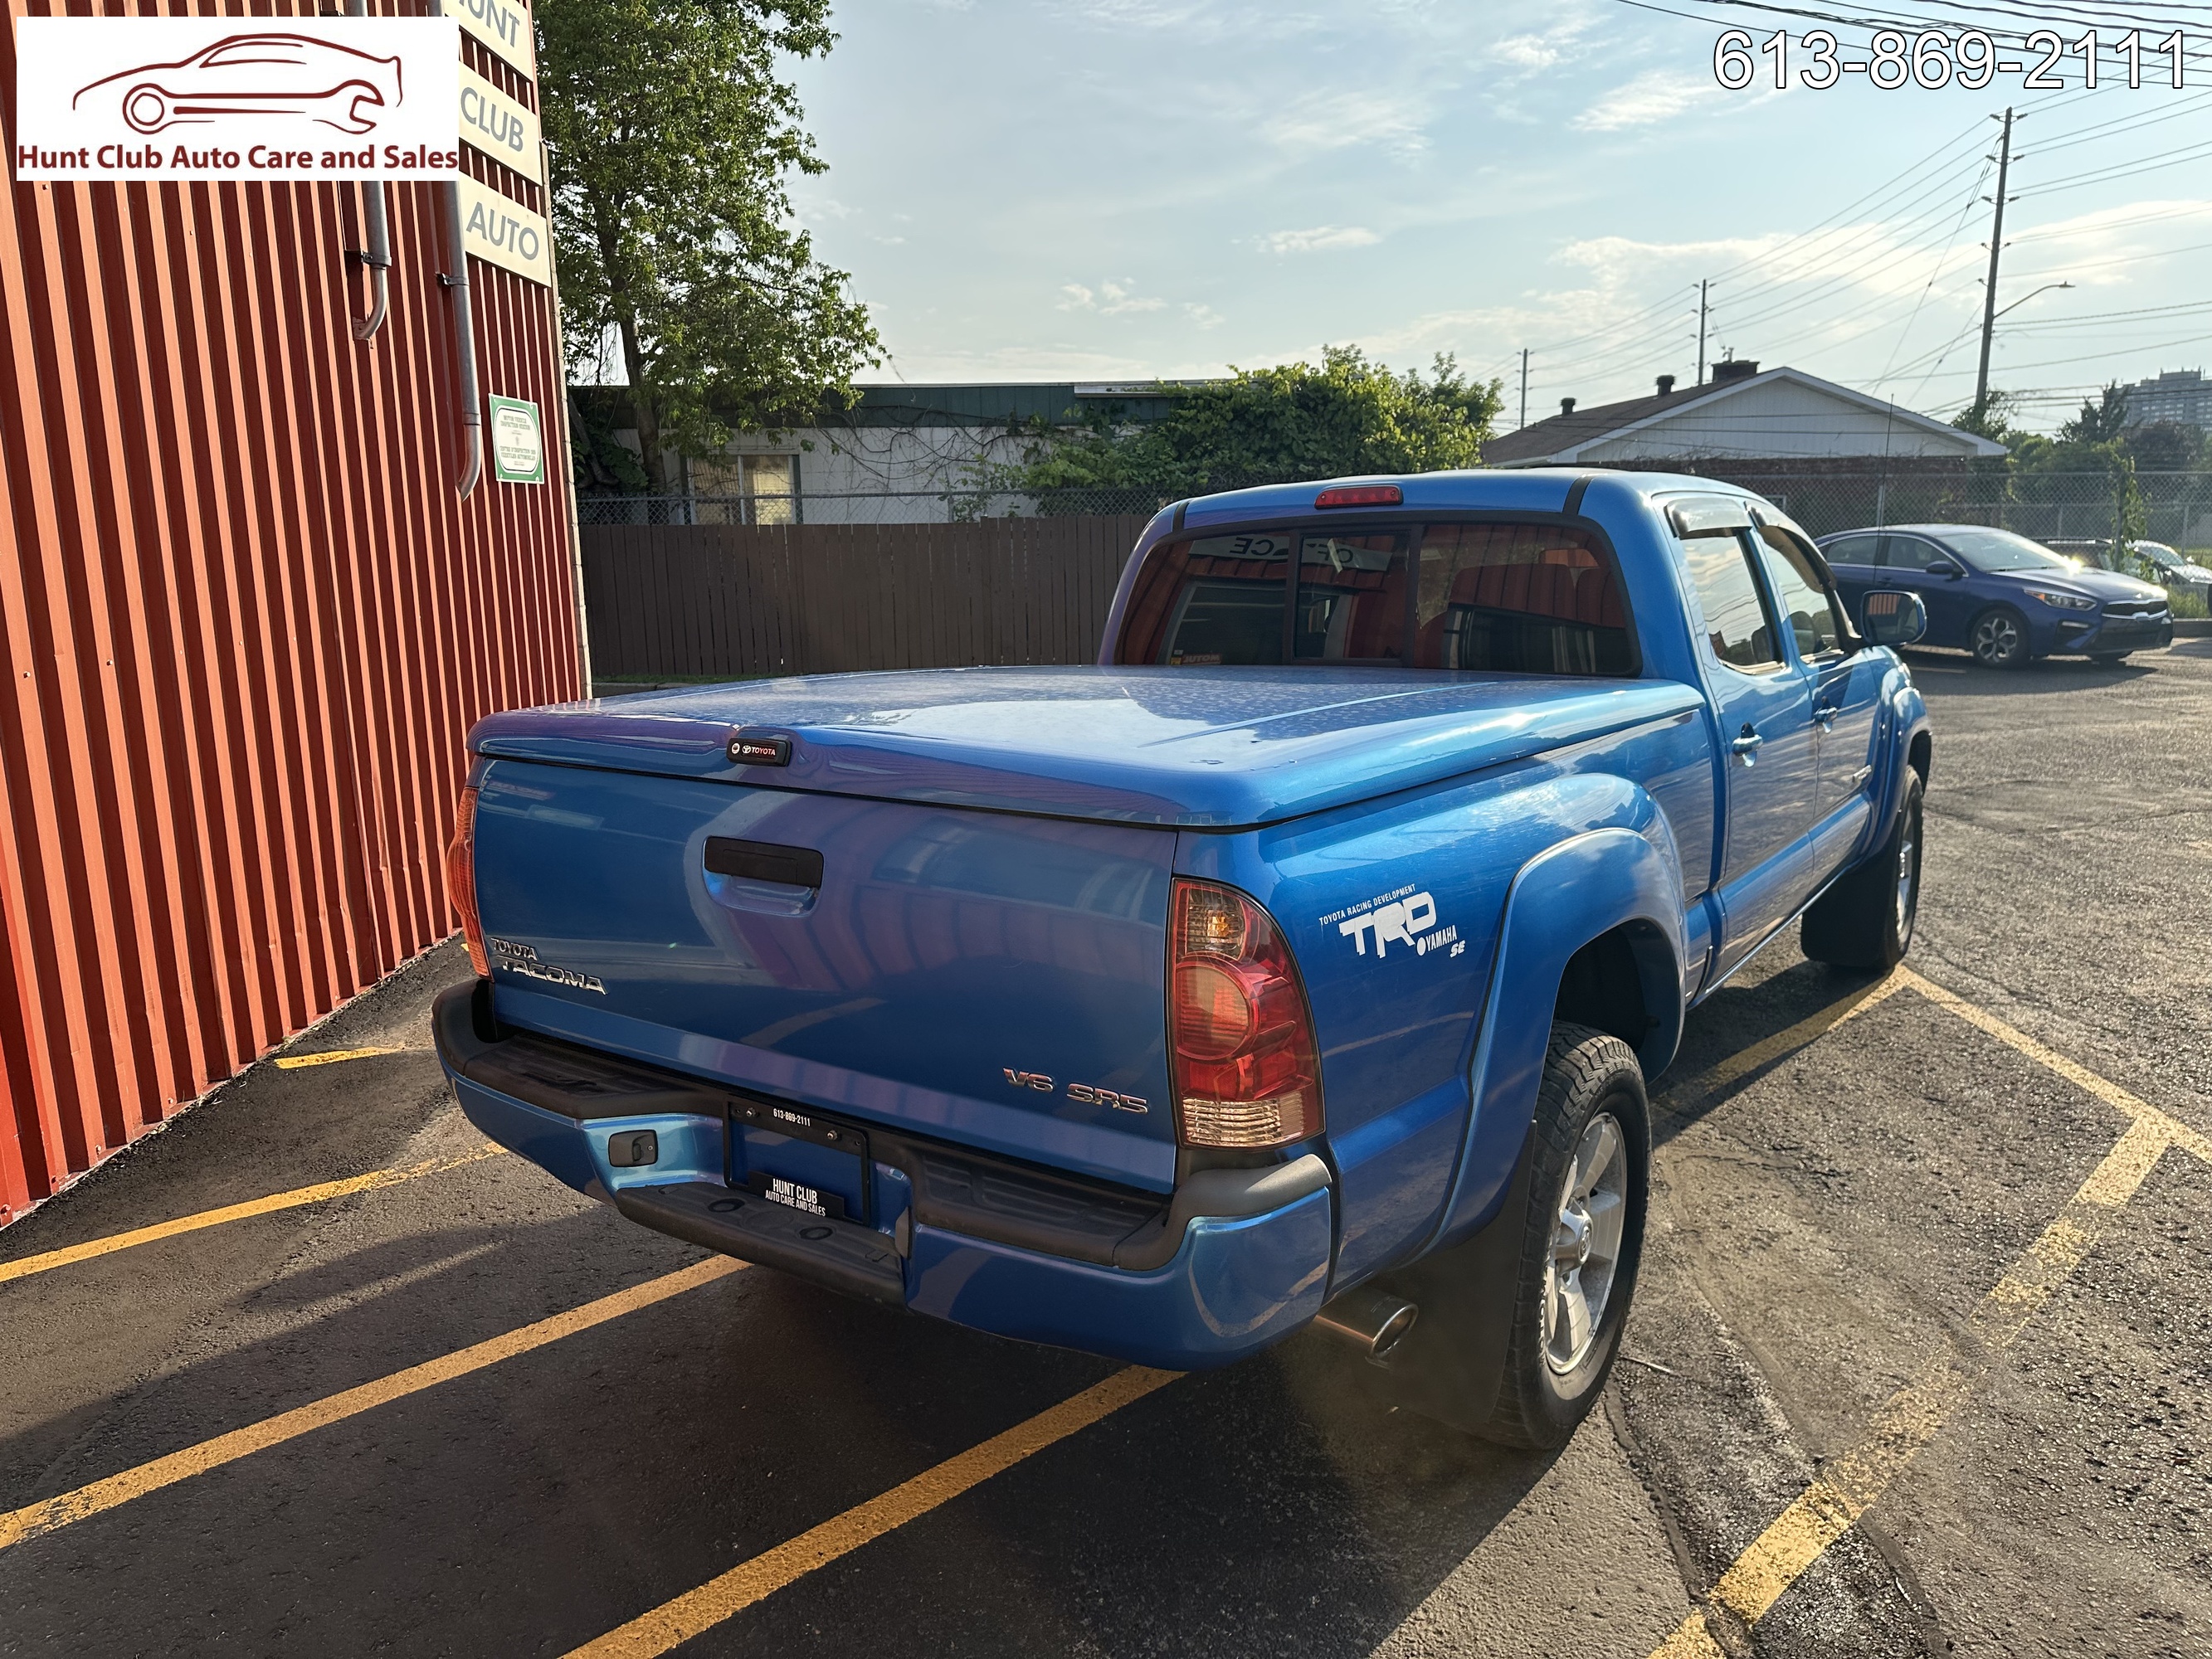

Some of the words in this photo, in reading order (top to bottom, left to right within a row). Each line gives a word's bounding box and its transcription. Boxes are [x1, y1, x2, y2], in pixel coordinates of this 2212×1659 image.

[458, 0, 520, 48] UNT
[460, 86, 524, 153] CLUB
[465, 201, 539, 260] AUTO
[751, 747, 776, 756] TOYOTA
[1318, 911, 1347, 927] TOYOTA
[1347, 899, 1373, 916] RACING
[1372, 883, 1416, 907] DEVELOPMENT
[1338, 891, 1437, 959] TRD
[1425, 924, 1459, 952] YAMAHA
[490, 937, 538, 961] TOYOTA
[1449, 939, 1466, 958] SE
[497, 954, 608, 995] TACOMA
[1002, 1067, 1055, 1093] V6
[1066, 1082, 1149, 1115] SR5
[772, 1107, 811, 1126] 613-869-2111
[765, 1190, 780, 1203] AUTO
[780, 1193, 795, 1208] CARE
[795, 1198, 807, 1211] AND
[808, 1202, 826, 1217] SALES
[772, 1178, 795, 1198] HUNT
[795, 1184, 818, 1204] CLUB
